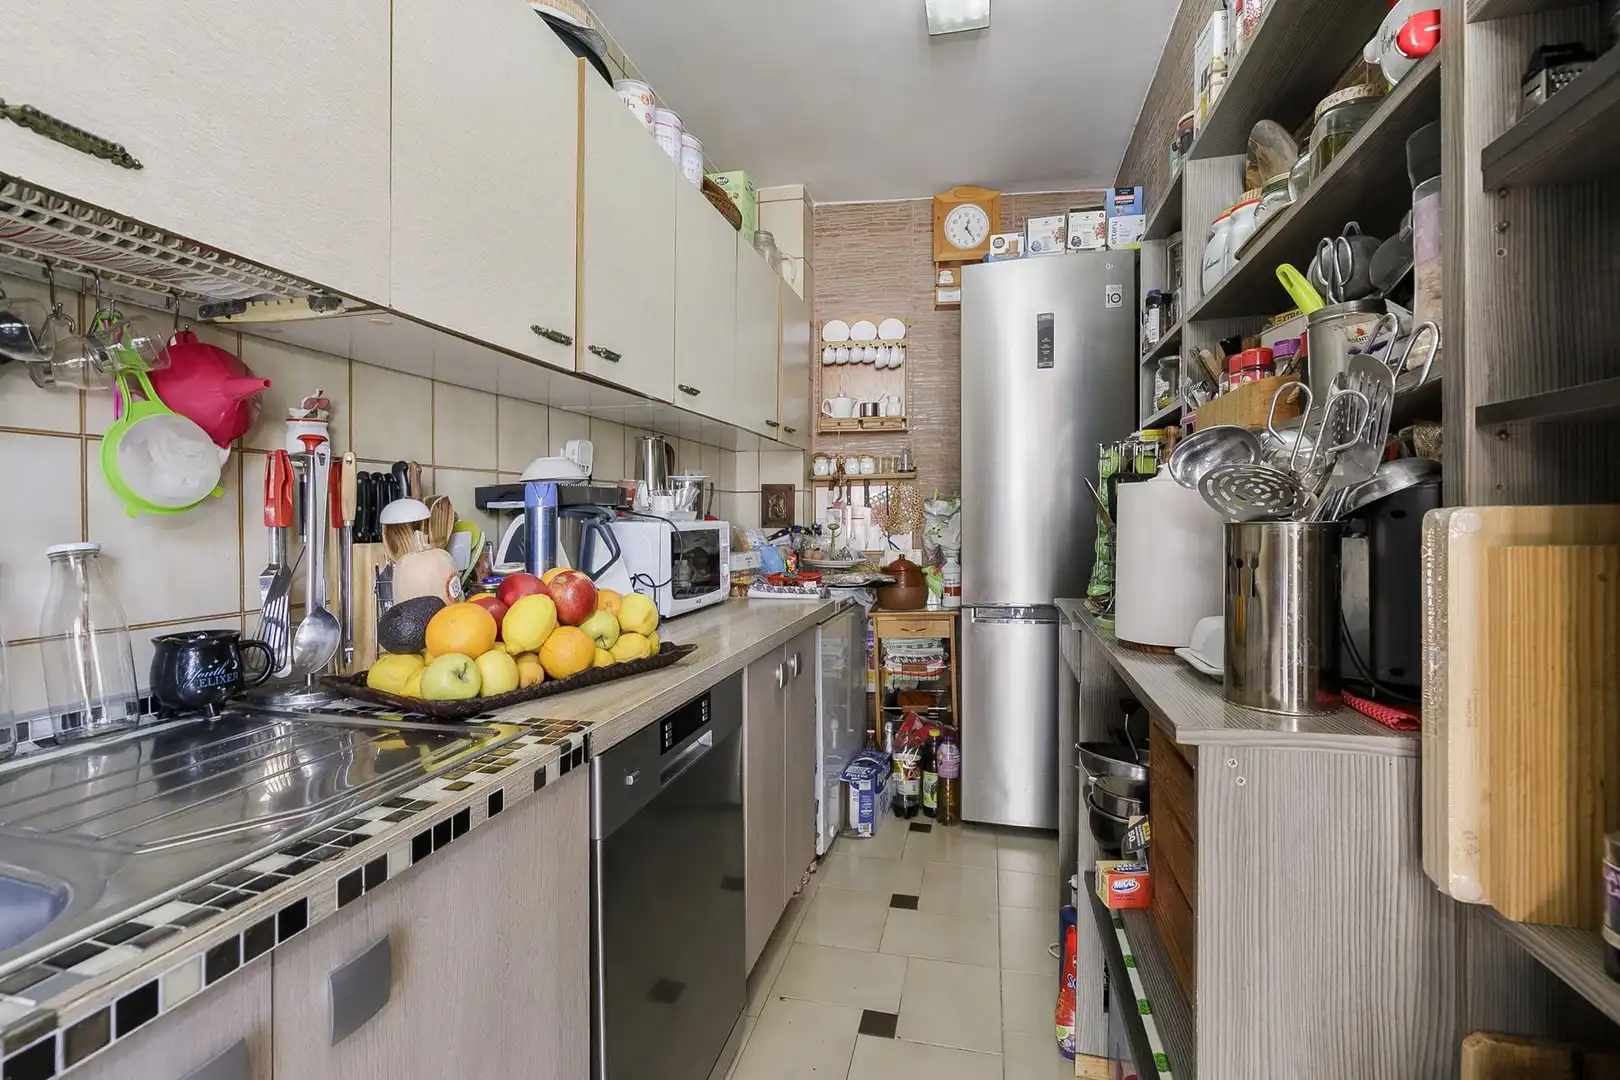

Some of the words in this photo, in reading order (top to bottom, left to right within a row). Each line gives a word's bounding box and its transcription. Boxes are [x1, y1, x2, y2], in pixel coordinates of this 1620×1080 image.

[1107, 293, 1121, 304] 10
[199, 672, 239, 688] ELIXER
[1128, 830, 1136, 842] 50
